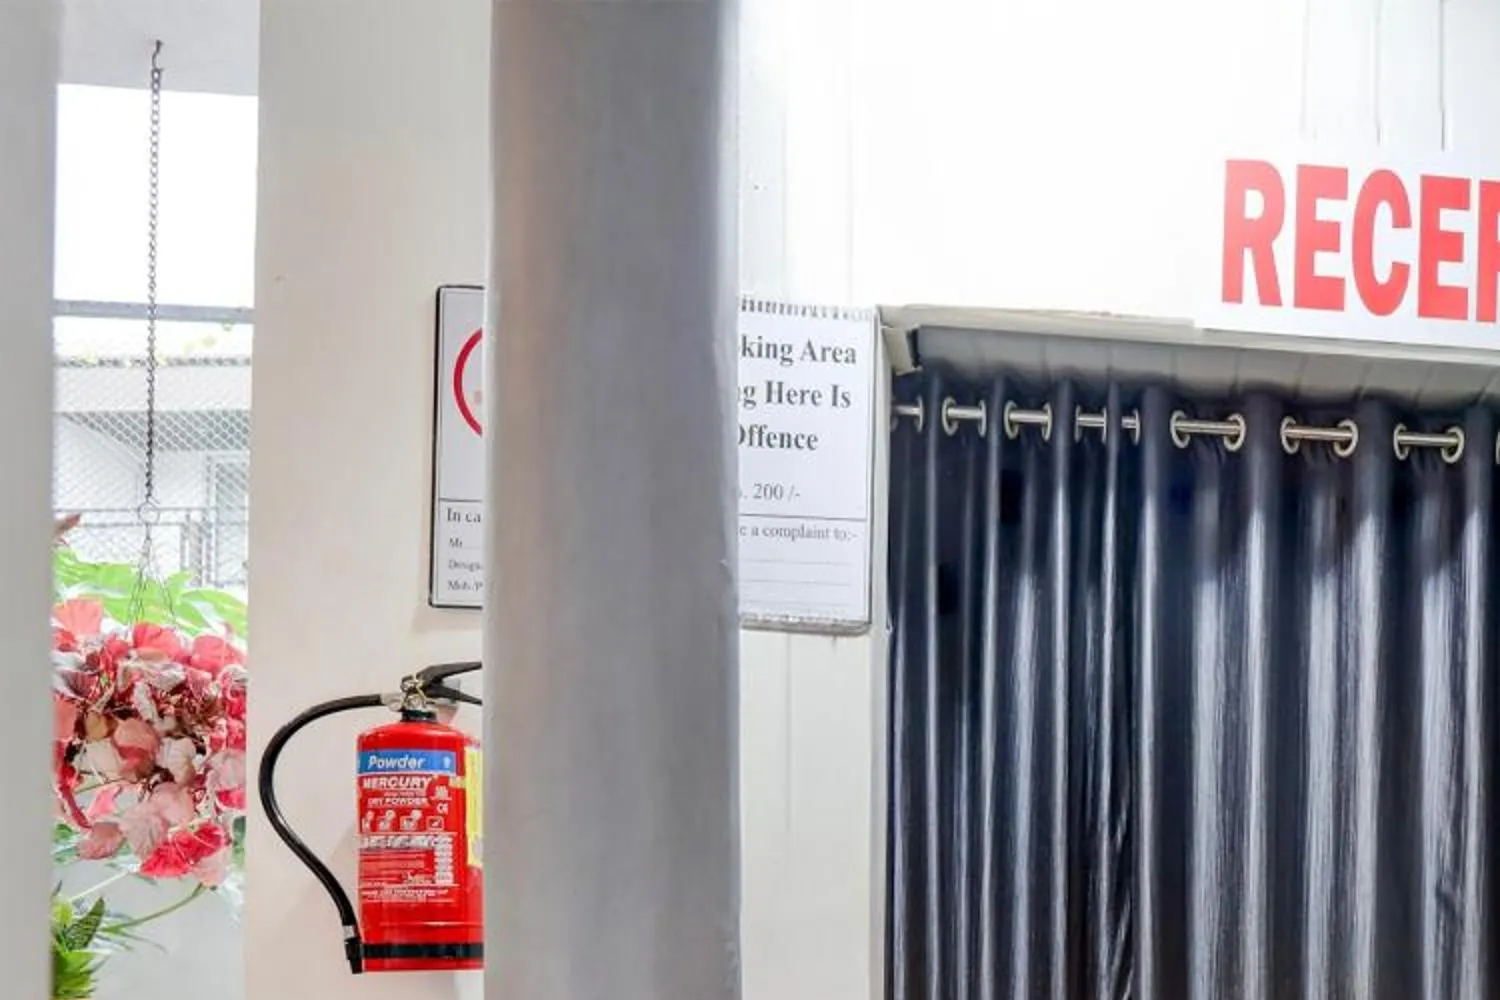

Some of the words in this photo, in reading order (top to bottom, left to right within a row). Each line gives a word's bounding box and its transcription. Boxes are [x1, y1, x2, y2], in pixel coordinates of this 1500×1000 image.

[741, 334, 793, 367] king
[800, 338, 857, 365] Area
[765, 380, 822, 407] Here
[831, 383, 851, 408] Is
[752, 482, 784, 500] 200
[447, 507, 461, 522] In
[465, 510, 481, 523] ca
[762, 523, 830, 542] complaint
[367, 754, 426, 770] Powder
[362, 775, 432, 790] MERCURY
